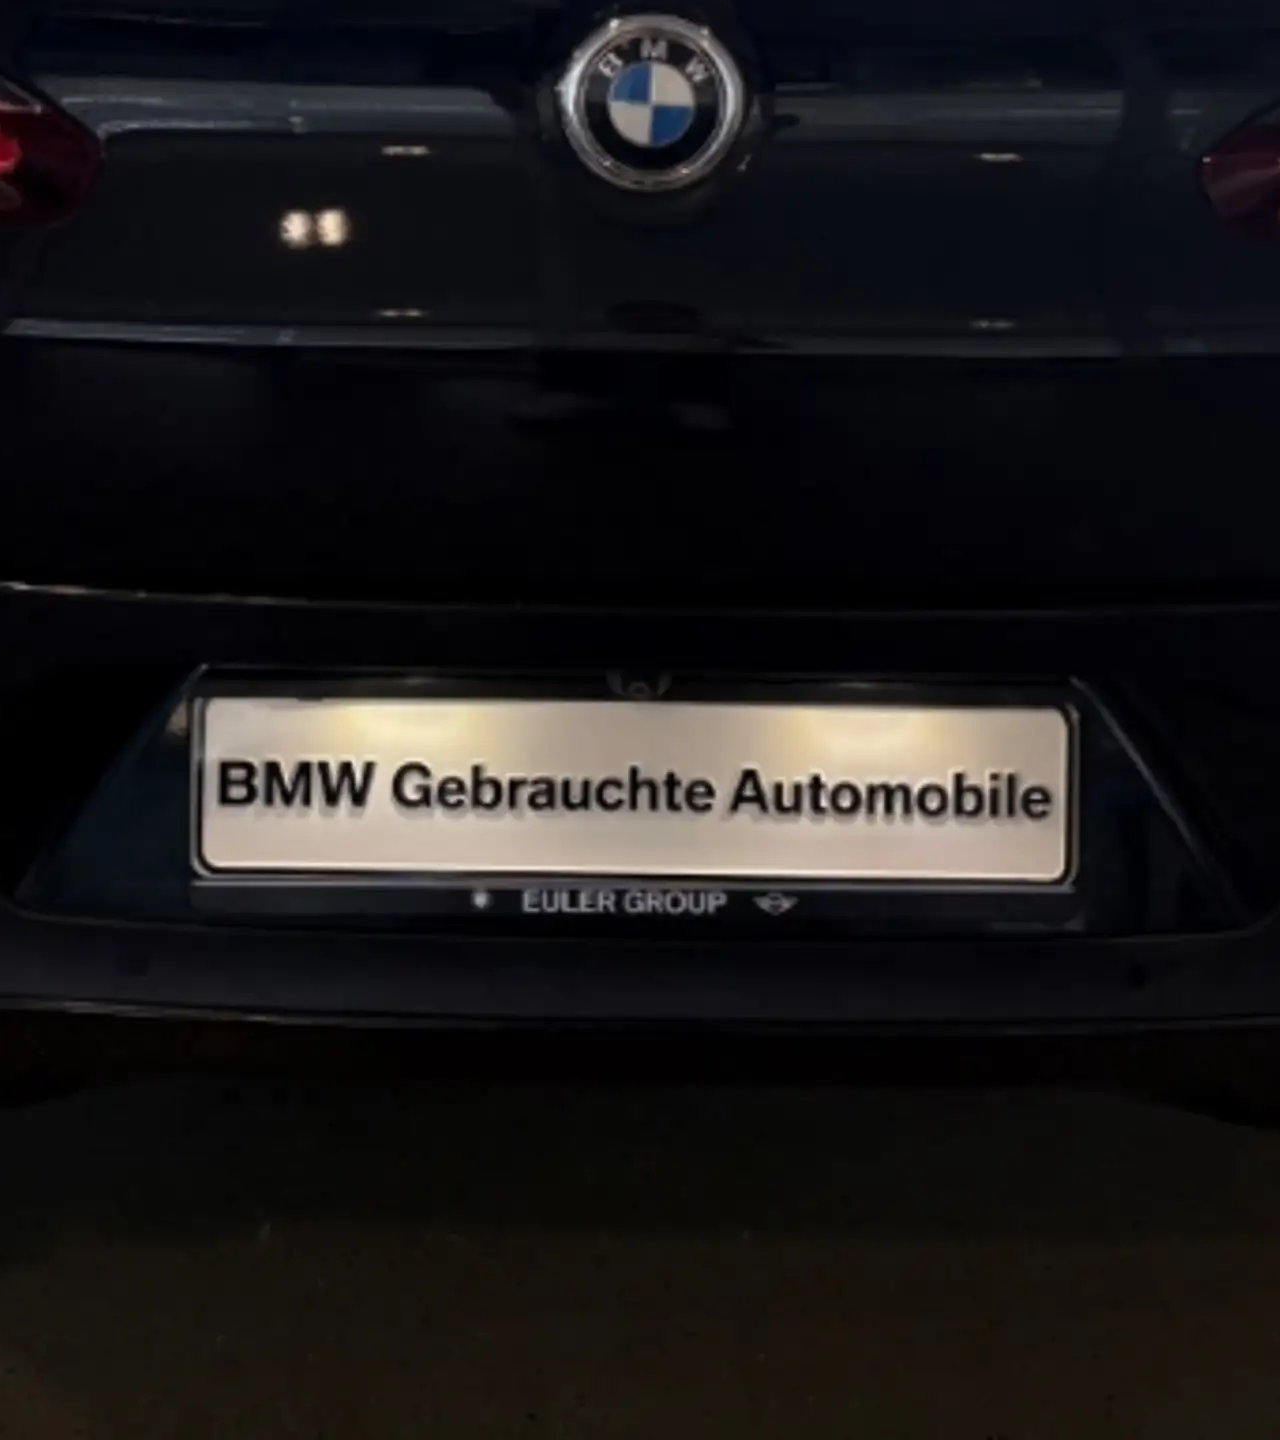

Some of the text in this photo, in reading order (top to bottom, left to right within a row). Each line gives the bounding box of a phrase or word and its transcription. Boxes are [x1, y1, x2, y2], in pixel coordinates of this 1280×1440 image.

[597, 37, 711, 82] BMW
[218, 760, 1052, 819] BMW Gebrauchte Automobile
[522, 891, 728, 914] EULER GROUP
